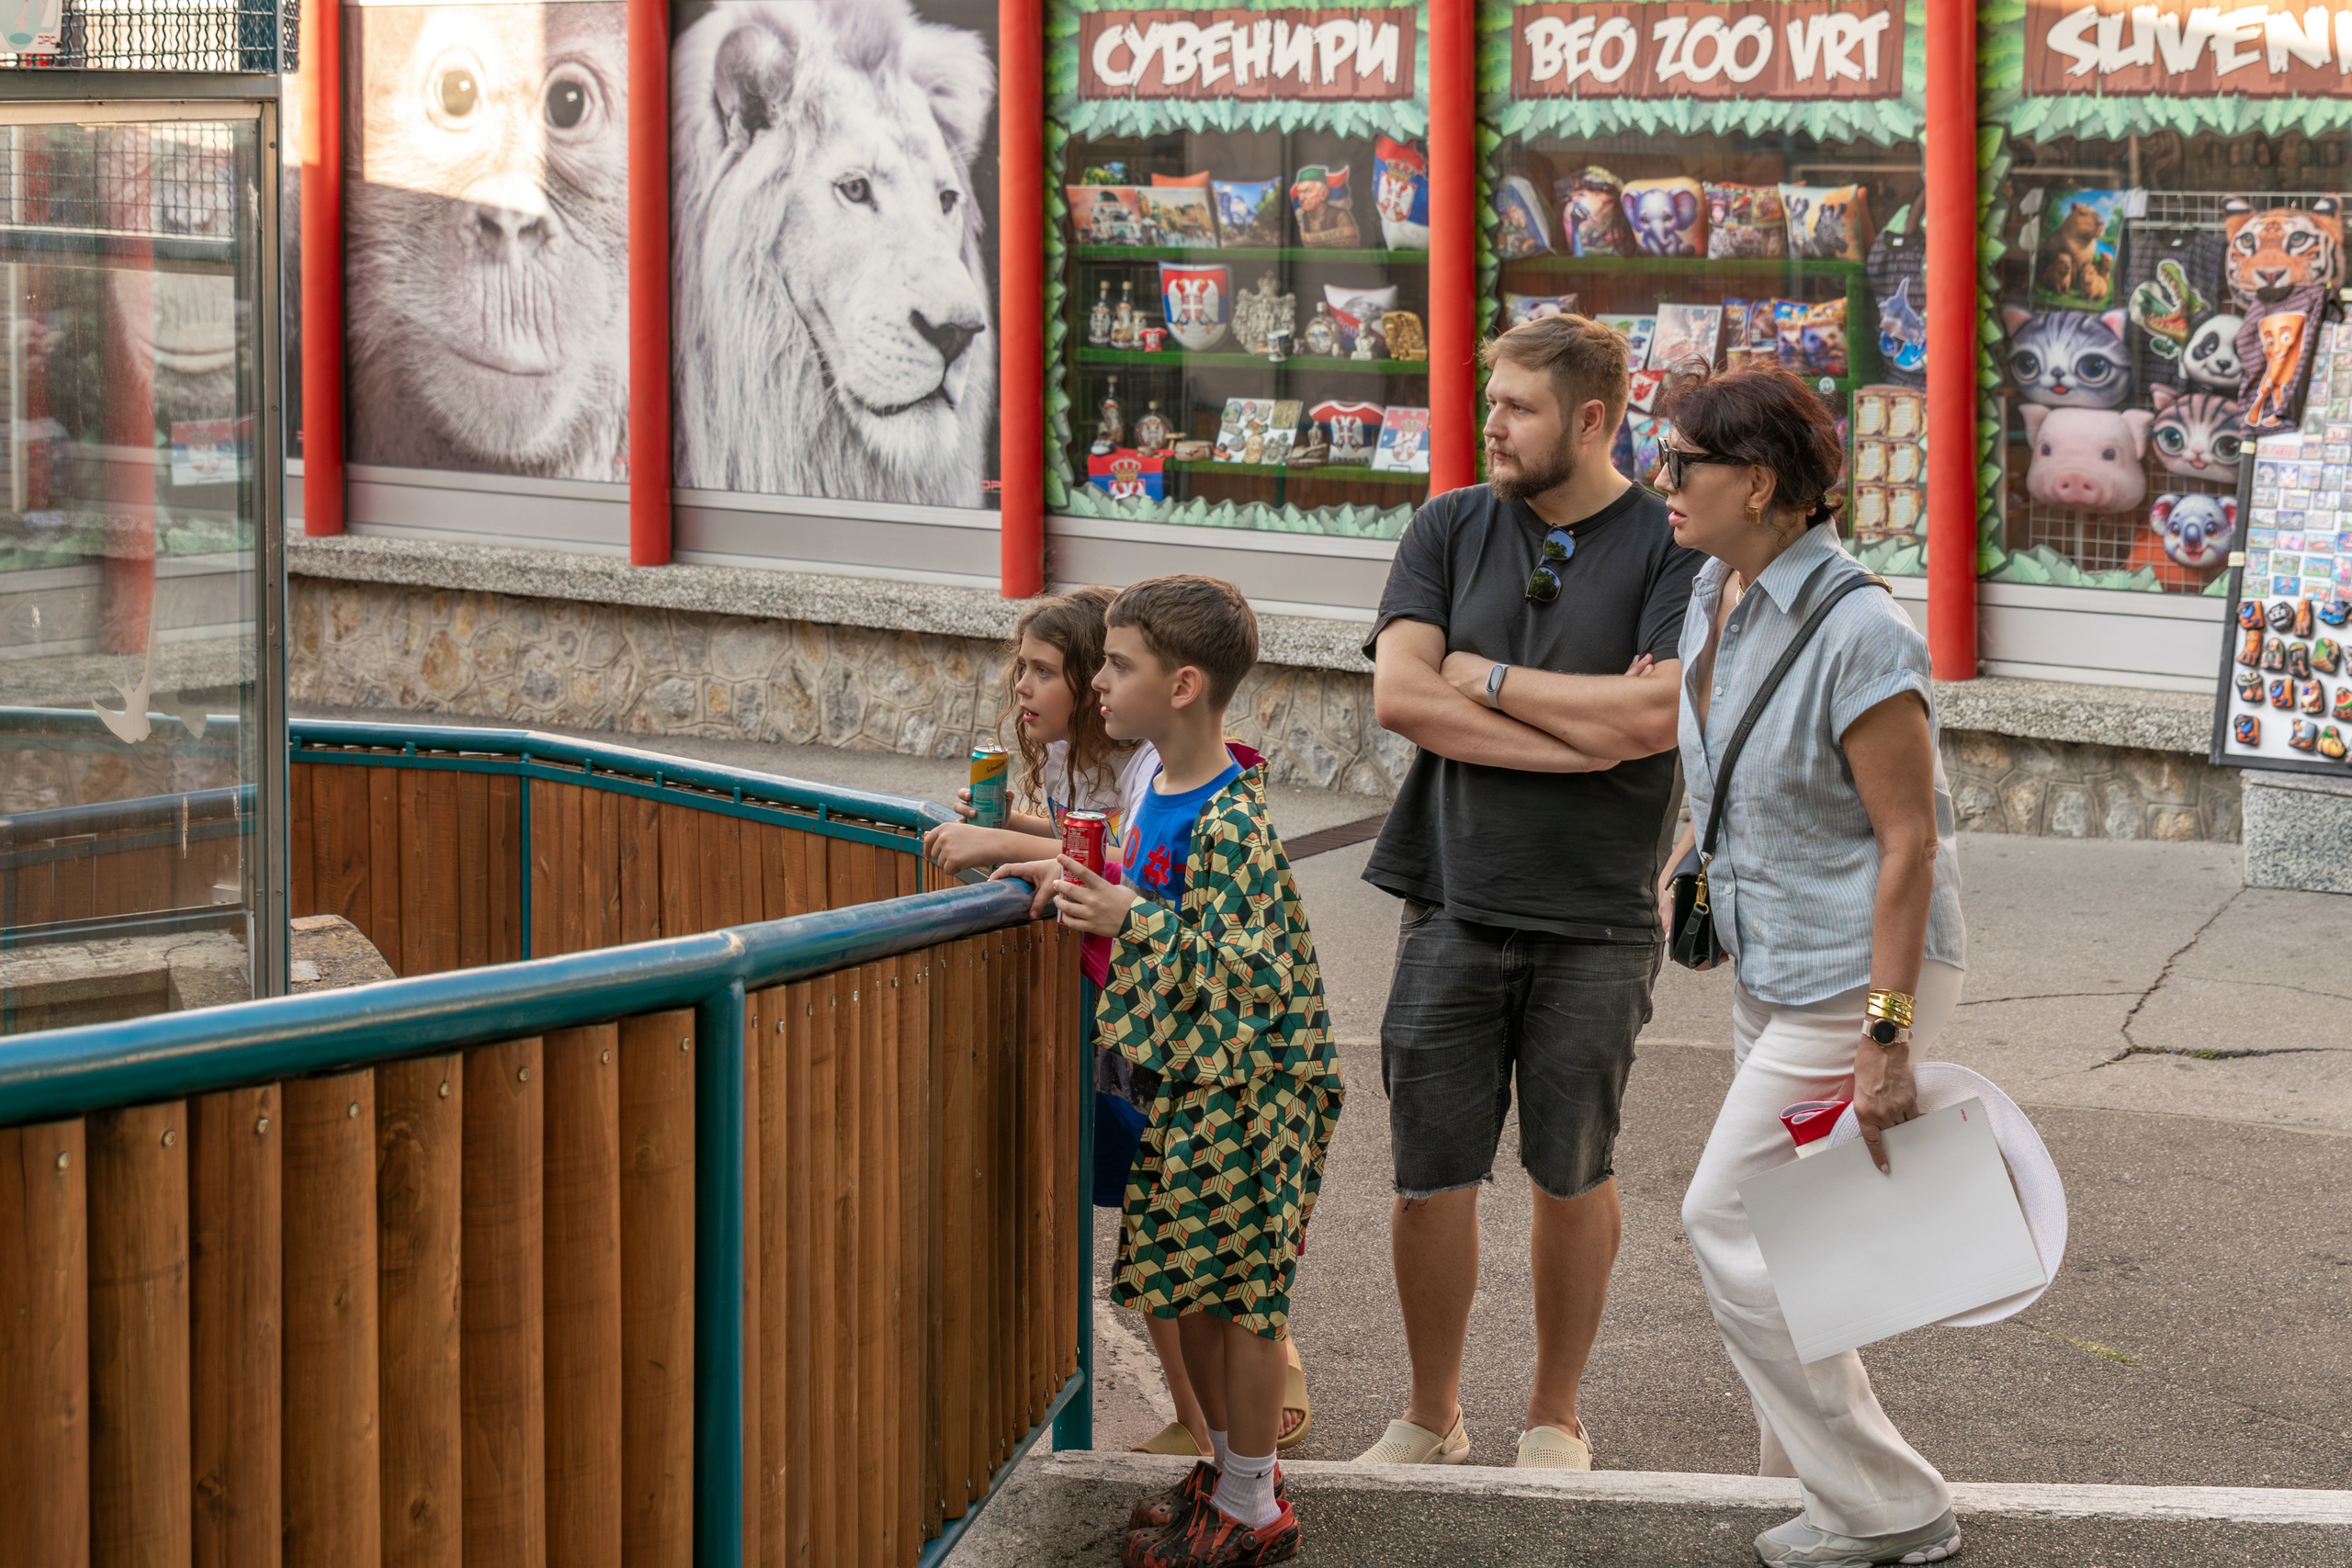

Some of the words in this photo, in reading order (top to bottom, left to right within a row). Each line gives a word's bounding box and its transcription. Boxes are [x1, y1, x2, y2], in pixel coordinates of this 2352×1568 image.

[1092, 17, 1399, 87] СУВЕНИРИ
[1524, 14, 1638, 85] BEO
[1653, 14, 1774, 84] ZOO
[1786, 9, 1891, 83] VRT
[980, 479, 1001, 491] DP
